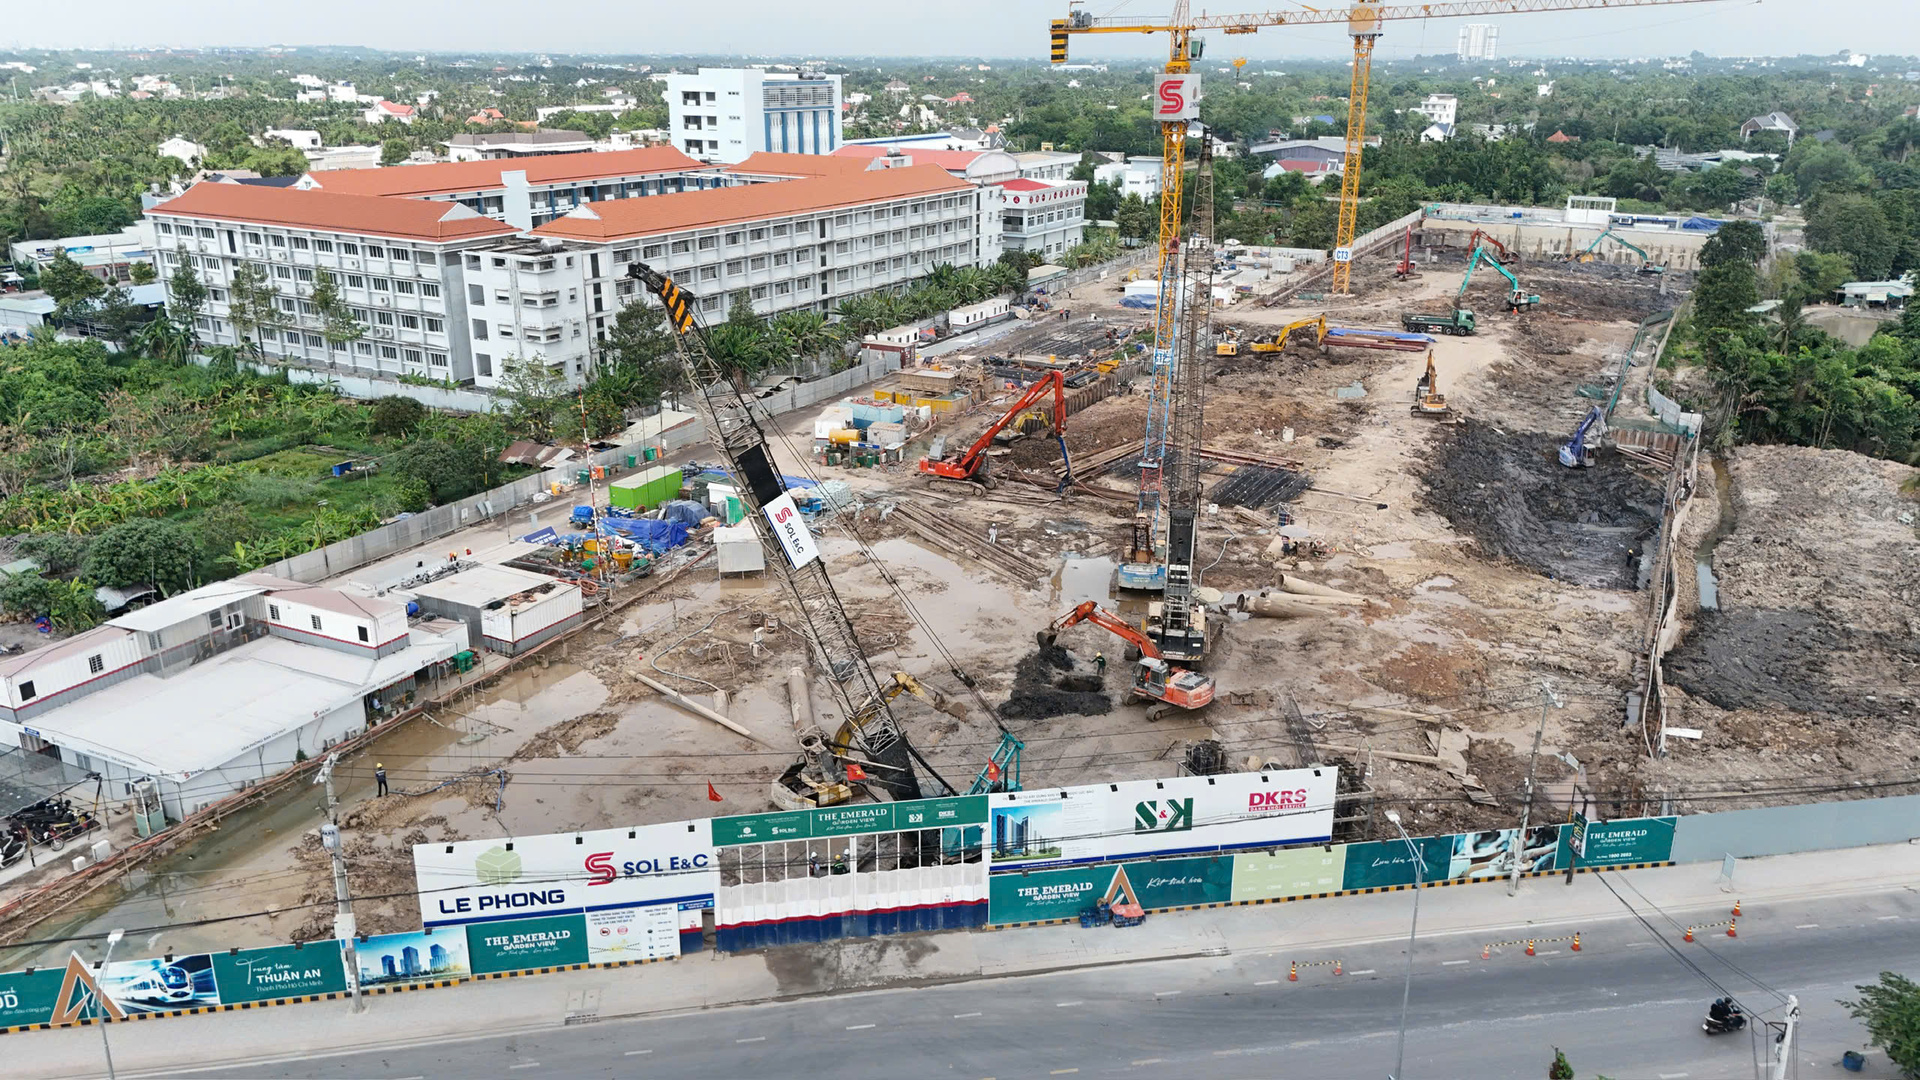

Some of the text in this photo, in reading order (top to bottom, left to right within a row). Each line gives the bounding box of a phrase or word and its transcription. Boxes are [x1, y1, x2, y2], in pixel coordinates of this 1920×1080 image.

[1336, 250, 1349, 260] CT3
[784, 522, 796, 539] SOL
[1249, 788, 1307, 806] DKRS
[818, 808, 887, 822] THE EMERALD
[1589, 829, 1648, 840] THE EMERALD
[623, 858, 663, 876] SOL
[669, 853, 709, 871] E&C
[1017, 882, 1094, 897] THE EMERALD
[1033, 893, 1062, 901] GARDEN
[439, 889, 566, 915] LE PHONG
[485, 930, 571, 947] THE EMERALD
[503, 940, 557, 951] GARDEN VIEW
[255, 968, 322, 984] THUẬN AN
